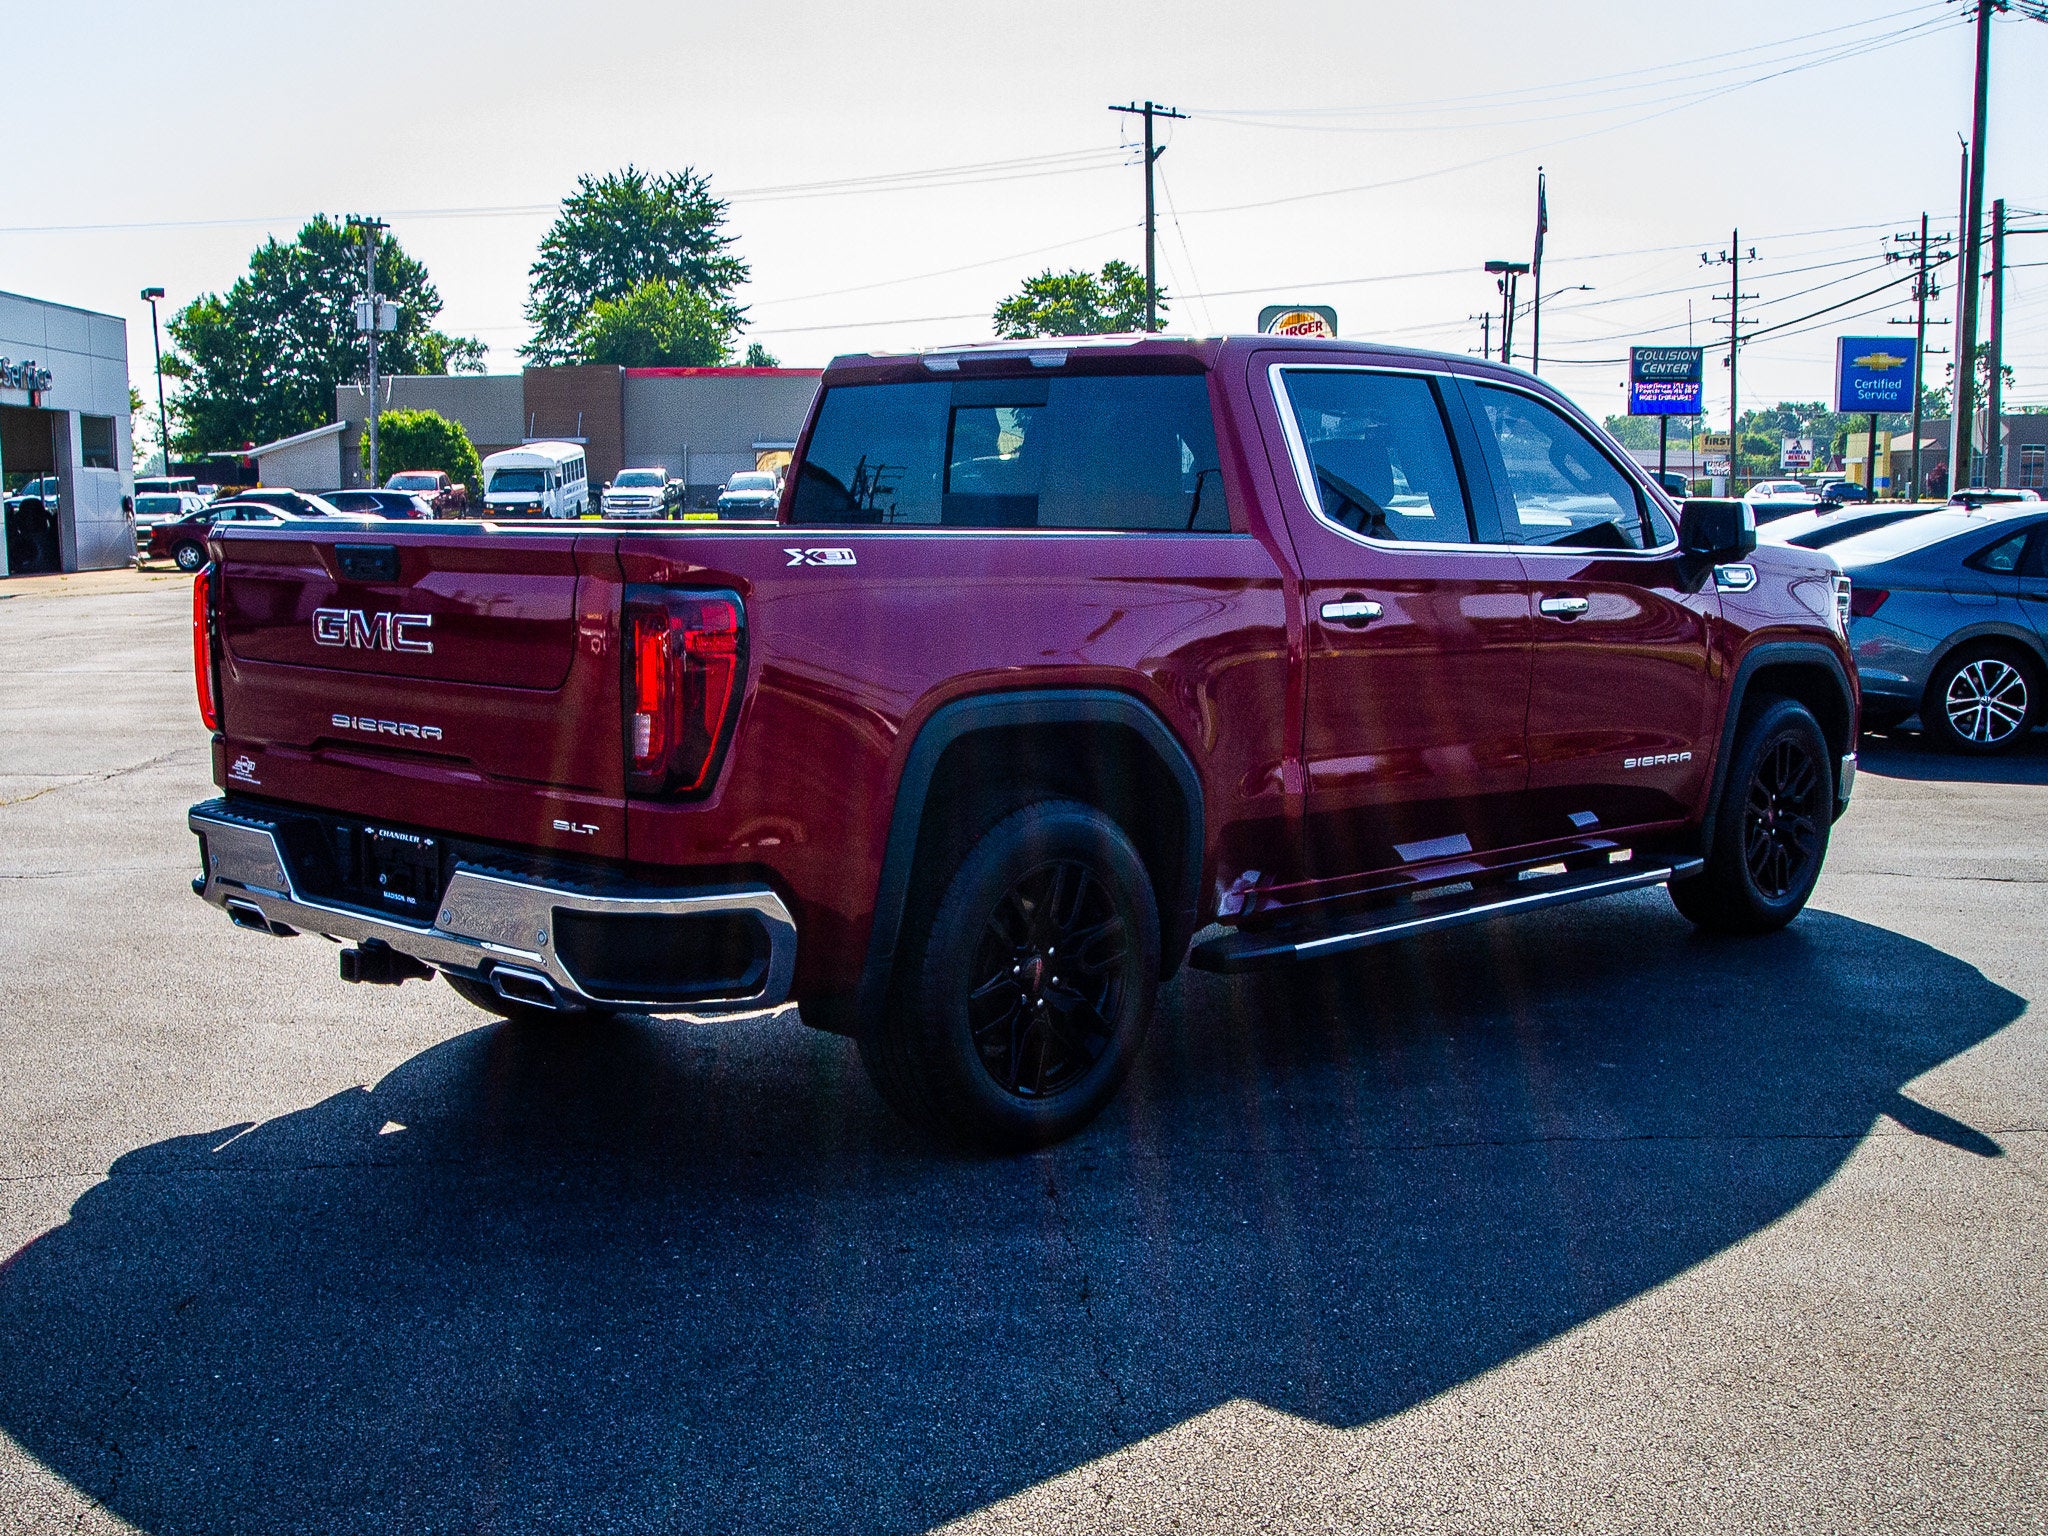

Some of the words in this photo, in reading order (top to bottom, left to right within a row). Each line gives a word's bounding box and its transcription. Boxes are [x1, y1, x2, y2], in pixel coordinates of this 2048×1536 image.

[1275, 321, 1323, 336] URGER
[1635, 349, 1699, 361] COLLISION
[1641, 362, 1689, 374] CENTER
[1854, 379, 1902, 389] Certified
[1858, 390, 1898, 400] Service
[312, 608, 434, 654] GMC
[331, 713, 443, 740] SIERRA
[1623, 751, 1692, 769] SIERRA
[553, 819, 600, 835] SLT
[379, 829, 420, 843] CHANDLER
